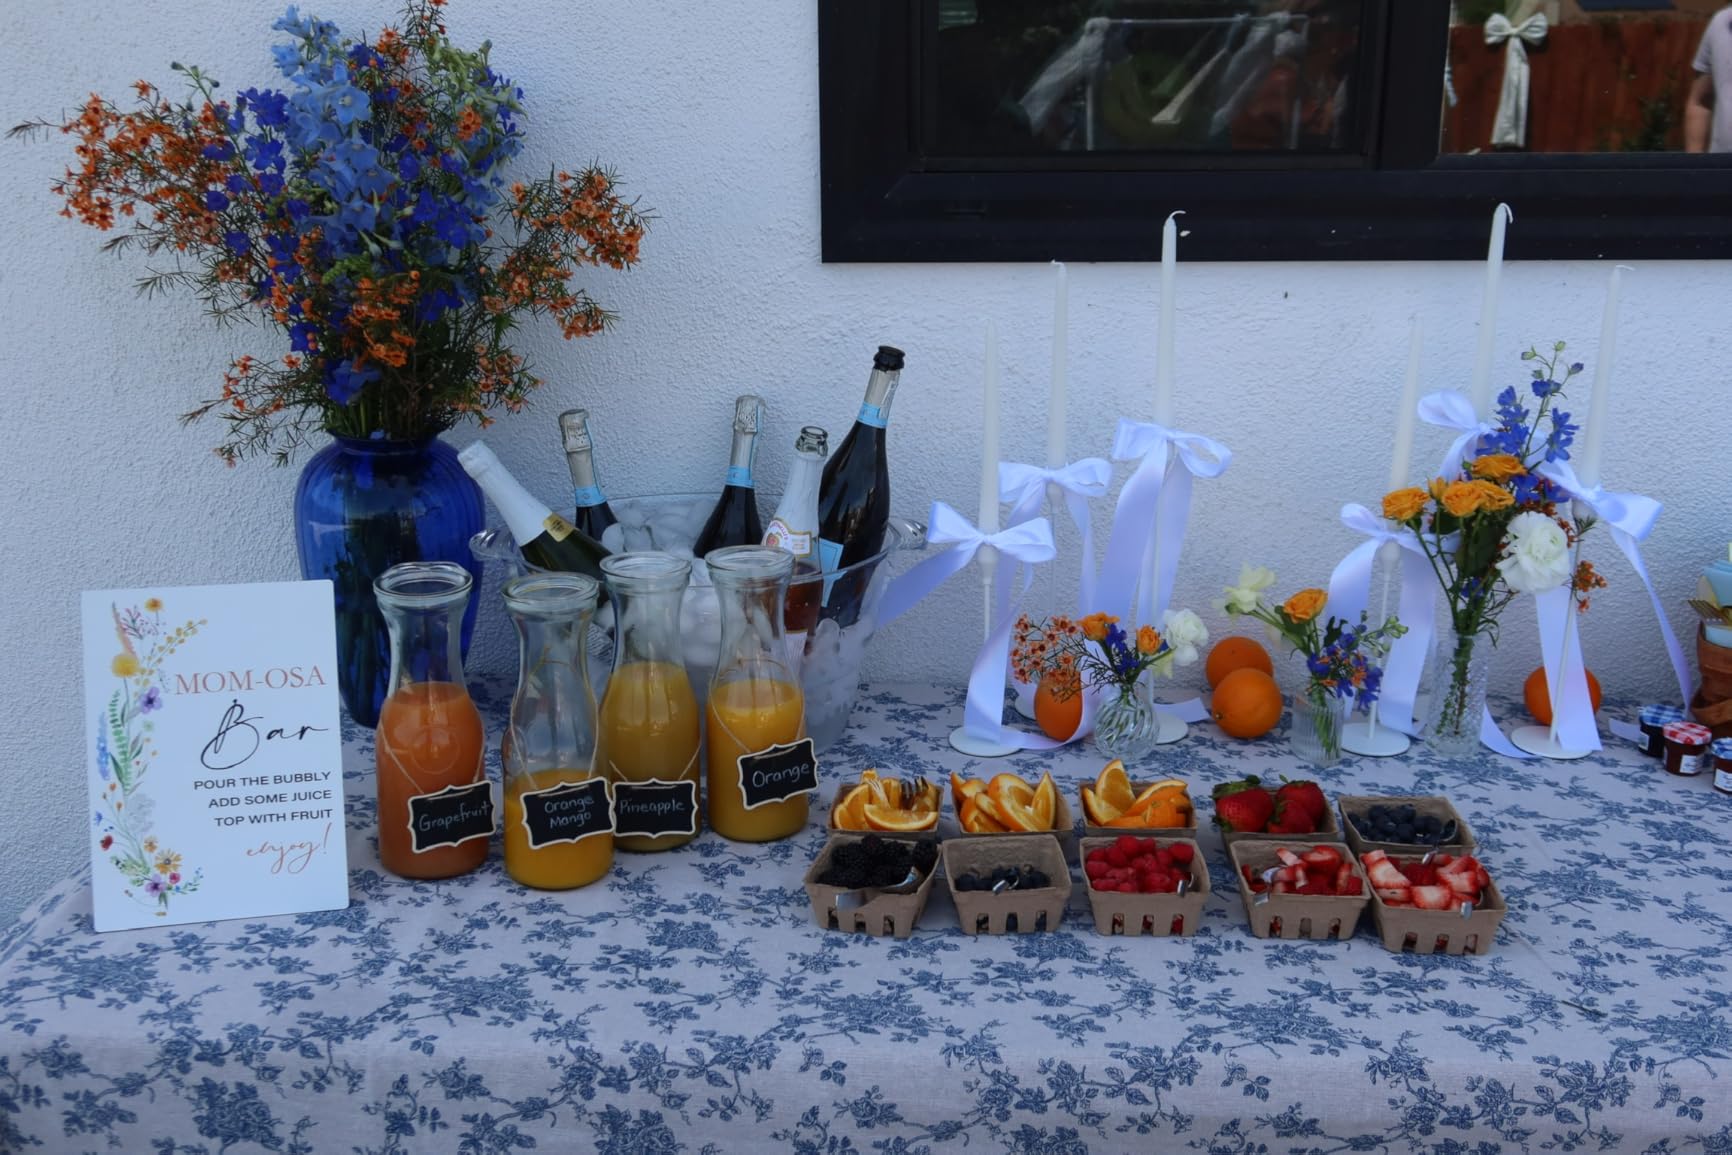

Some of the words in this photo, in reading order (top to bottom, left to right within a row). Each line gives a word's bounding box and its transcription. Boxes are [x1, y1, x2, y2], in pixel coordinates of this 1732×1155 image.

[174, 664, 327, 695] MOM-OSA
[200, 698, 329, 770] Bar
[194, 779, 236, 790] POUR
[240, 776, 269, 786] THE
[273, 771, 331, 785] BUBBLY
[752, 762, 810, 788] Orange
[208, 797, 240, 808] ADD
[244, 793, 288, 805] SOME
[291, 790, 332, 802] JUICE
[544, 796, 595, 814] Orange
[619, 799, 685, 816] Pineapple
[214, 816, 245, 827] TOP
[248, 813, 286, 824] WITH
[291, 809, 333, 821] FRUIT
[418, 801, 491, 832] Grapefruit
[549, 812, 592, 829] Mango
[246, 822, 332, 874] enjoy!
